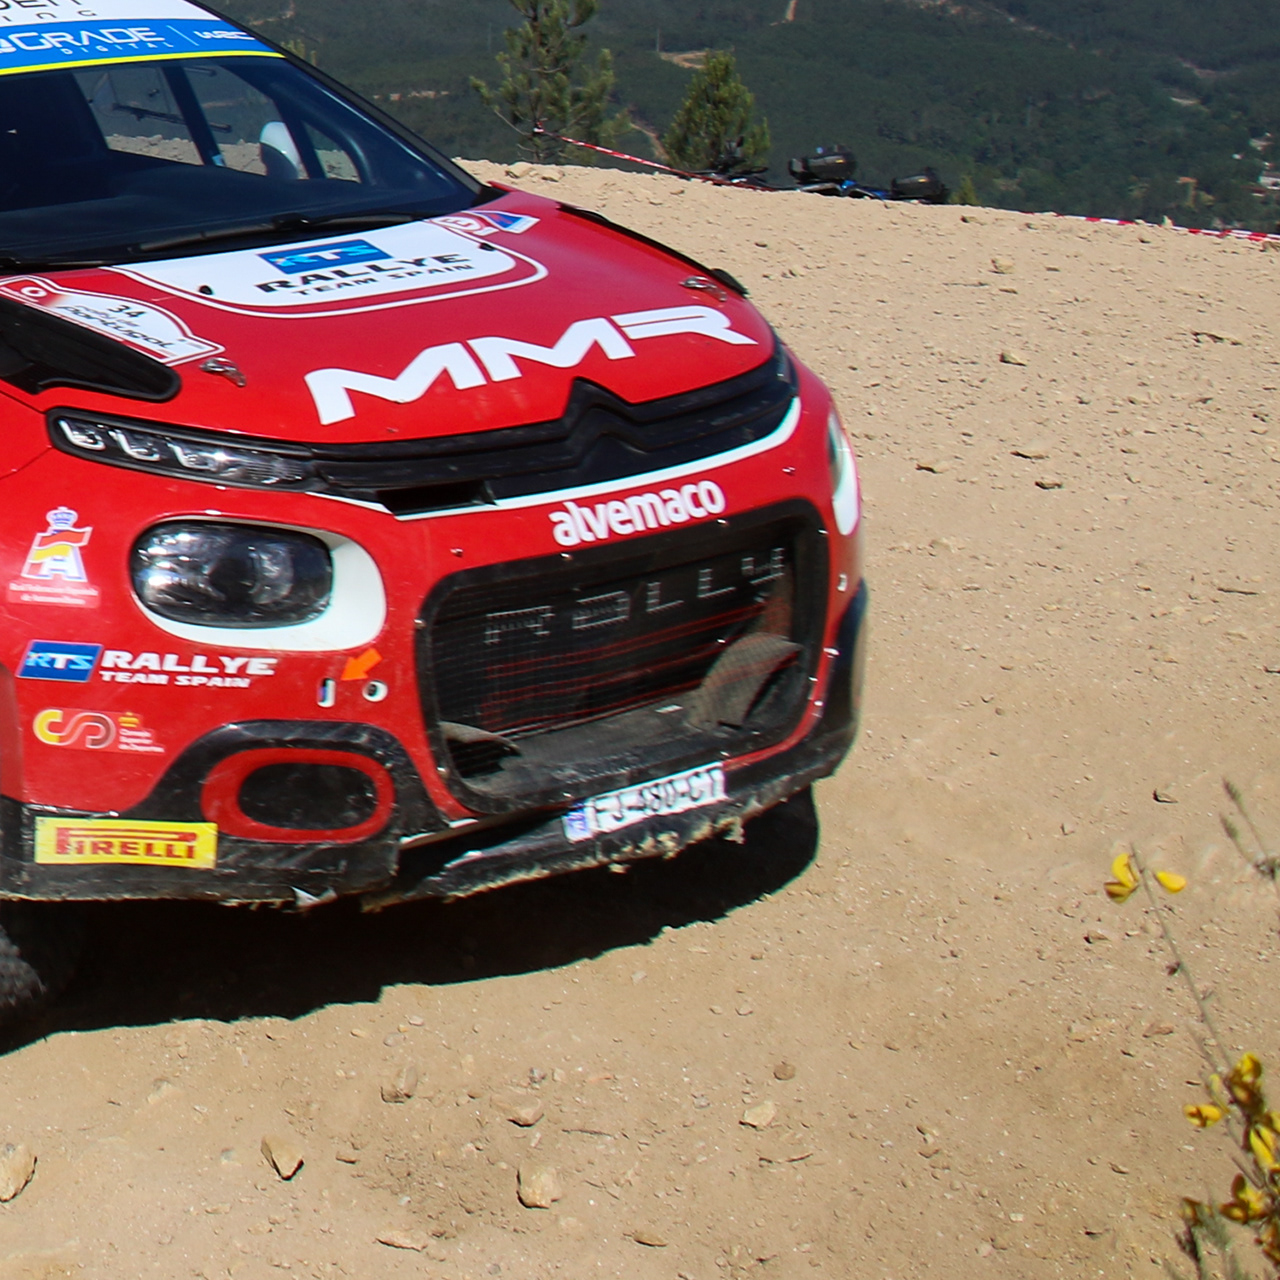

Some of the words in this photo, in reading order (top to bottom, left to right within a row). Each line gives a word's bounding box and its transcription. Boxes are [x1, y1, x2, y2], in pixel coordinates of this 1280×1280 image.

[61, 41, 174, 56] DIGITAL
[268, 243, 378, 265] RTS
[254, 253, 471, 293] RALLYE
[292, 277, 376, 295] TEAM
[387, 264, 475, 280] SPAIN
[107, 304, 146, 318] 34
[304, 305, 758, 426] MMR
[548, 480, 726, 547] alvemaco
[26, 651, 94, 670] RTS
[100, 649, 278, 676] RALLYE
[99, 670, 168, 686] TEAM
[174, 674, 251, 688] SPAIN
[55, 826, 199, 859] PIRELLI
